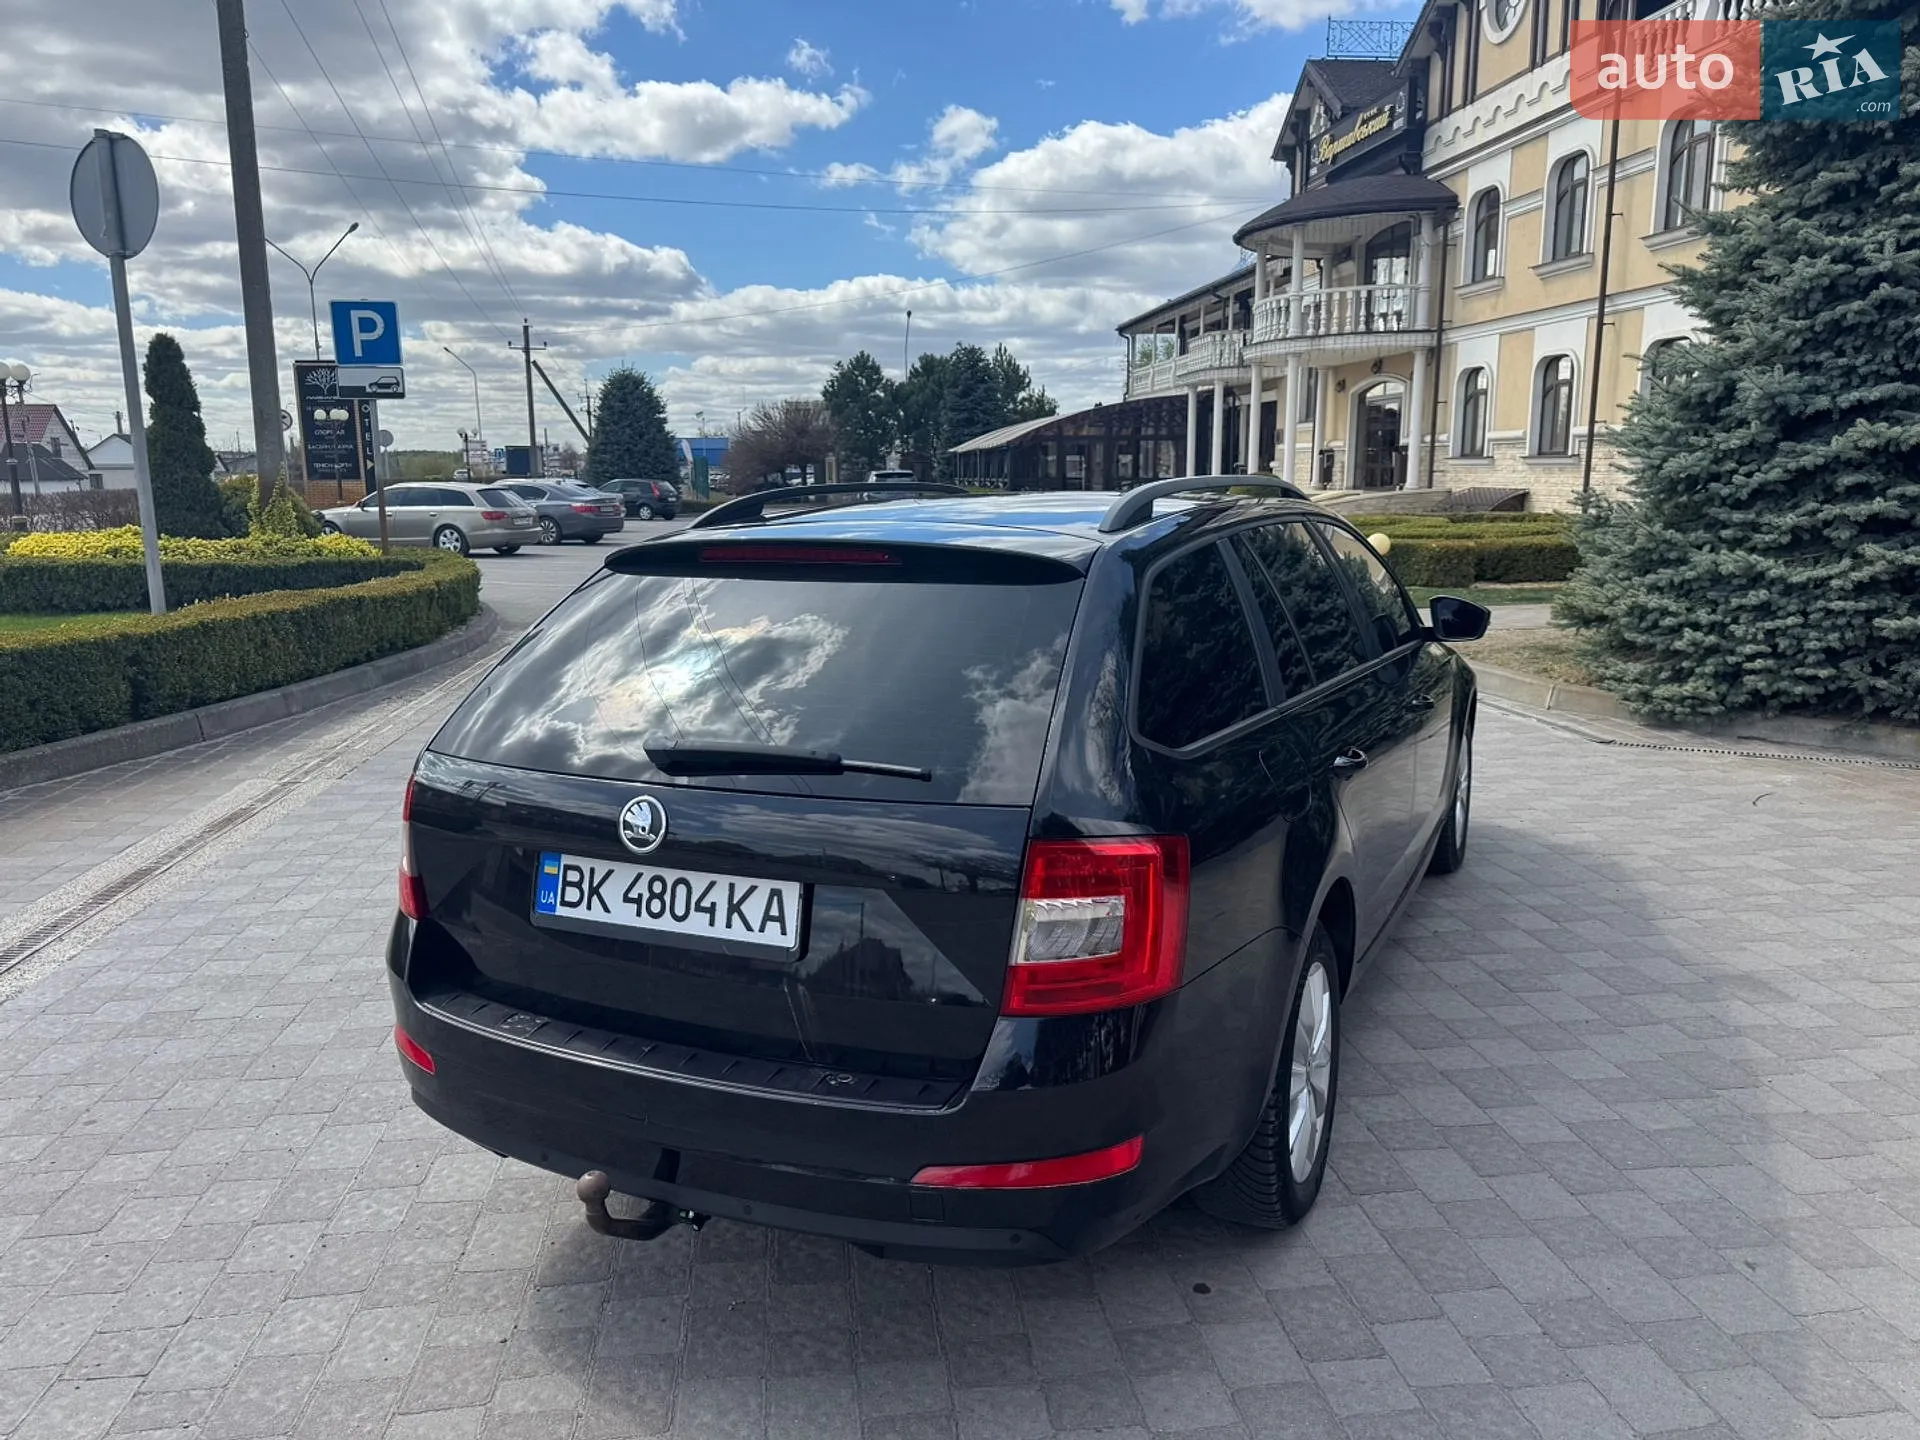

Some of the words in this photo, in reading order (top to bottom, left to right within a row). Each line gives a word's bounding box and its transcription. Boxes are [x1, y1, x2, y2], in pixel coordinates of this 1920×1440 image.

[350, 309, 385, 357] P
[540, 889, 555, 906] UA
[558, 863, 615, 914] BK
[622, 871, 718, 928] 4804
[724, 881, 788, 936] KA
